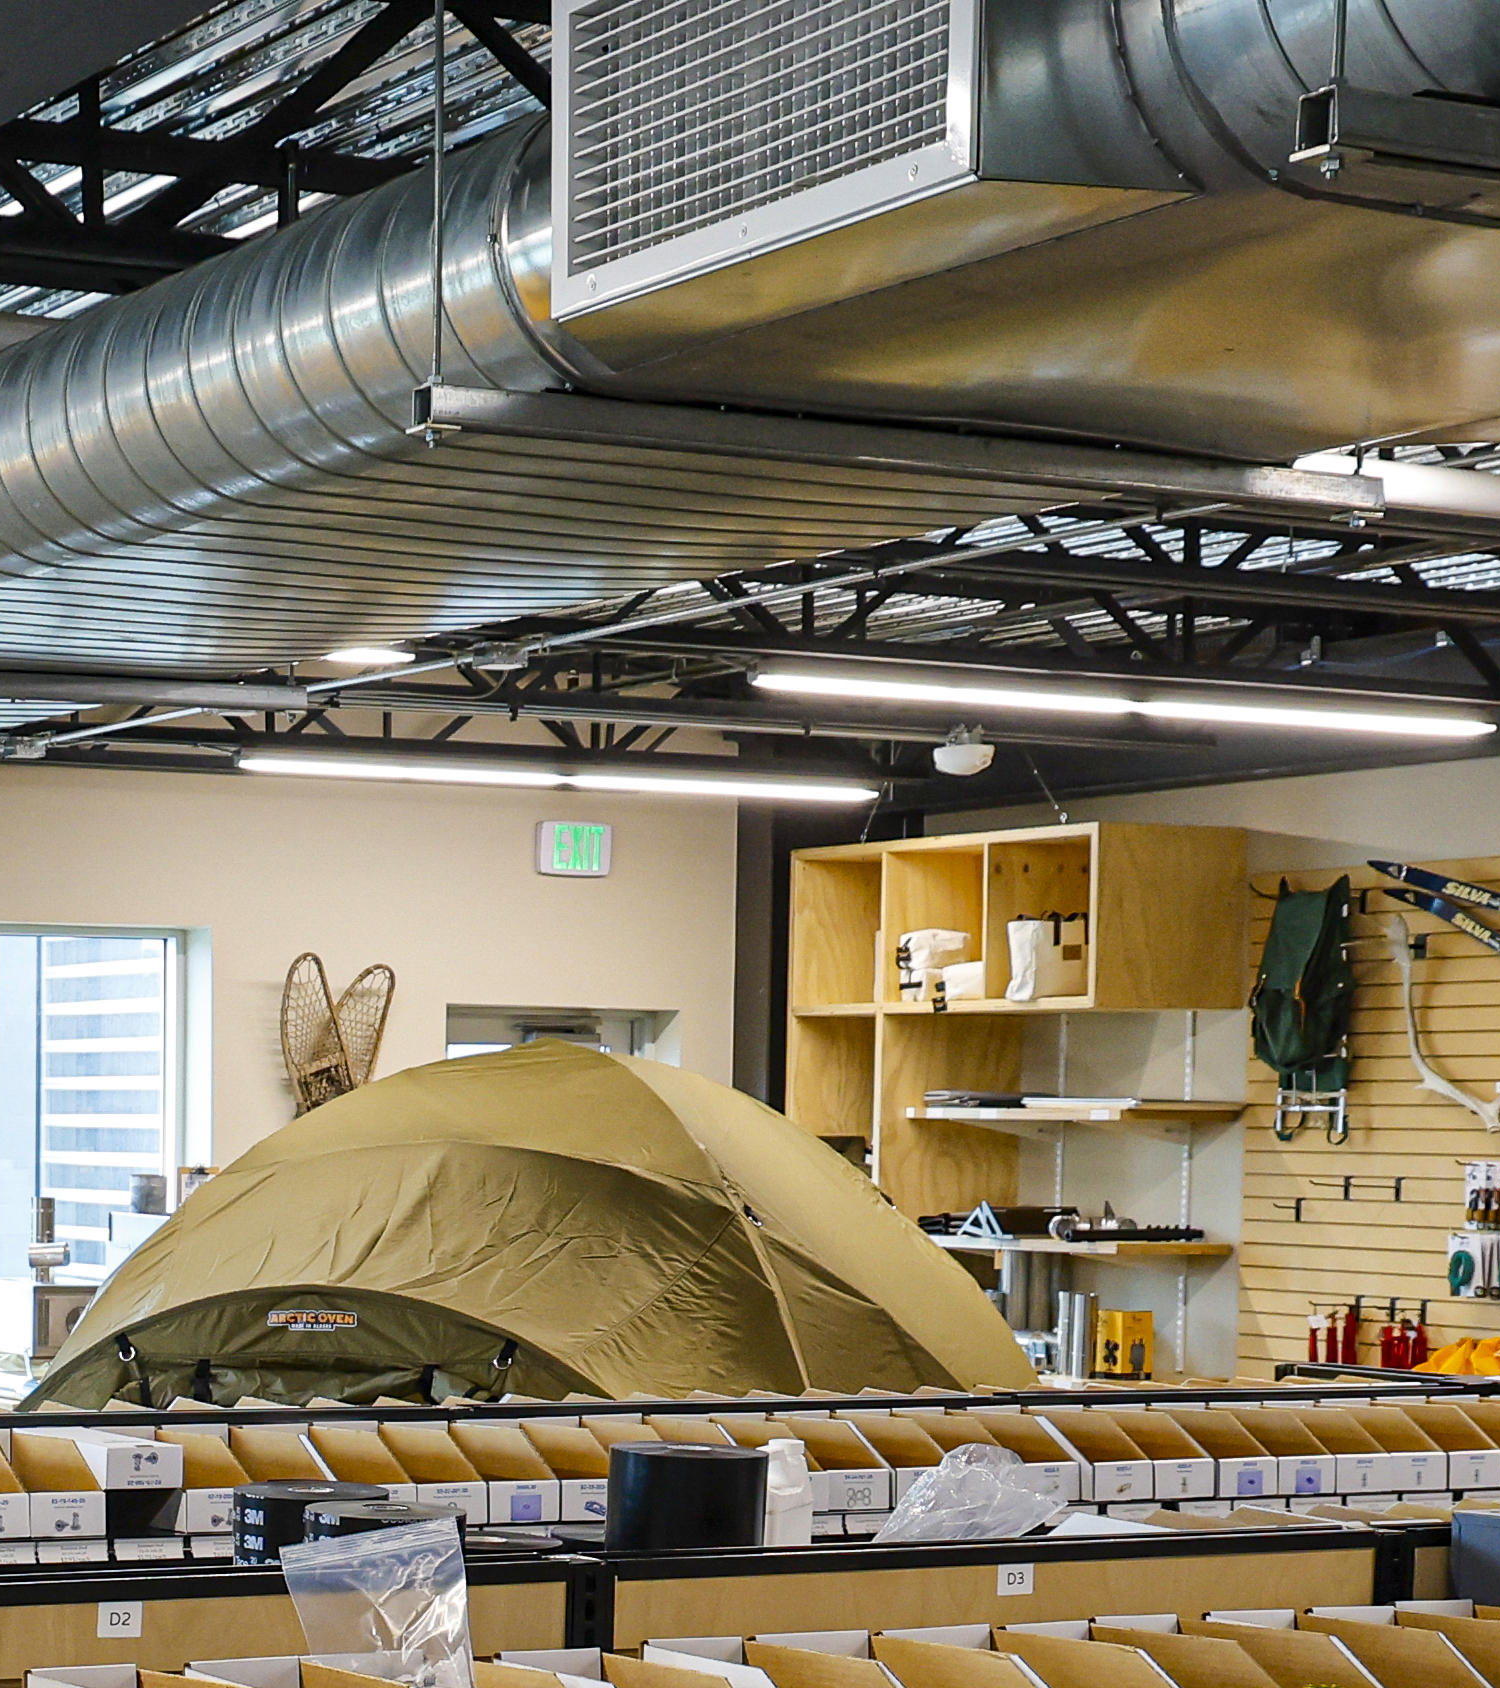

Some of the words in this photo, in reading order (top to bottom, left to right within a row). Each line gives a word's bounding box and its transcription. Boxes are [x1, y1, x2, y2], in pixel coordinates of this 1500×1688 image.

[553, 824, 604, 871] EXIT
[1442, 881, 1491, 905] SILVA
[1452, 913, 1491, 941] SILVA
[269, 1313, 317, 1323] ARCTIC
[318, 1312, 354, 1324] OVEN
[244, 1508, 264, 1526] 3M
[318, 1510, 341, 1526] 3M
[244, 1535, 264, 1551] 3M
[1006, 1570, 1026, 1588] D3
[109, 1611, 131, 1627] D2
